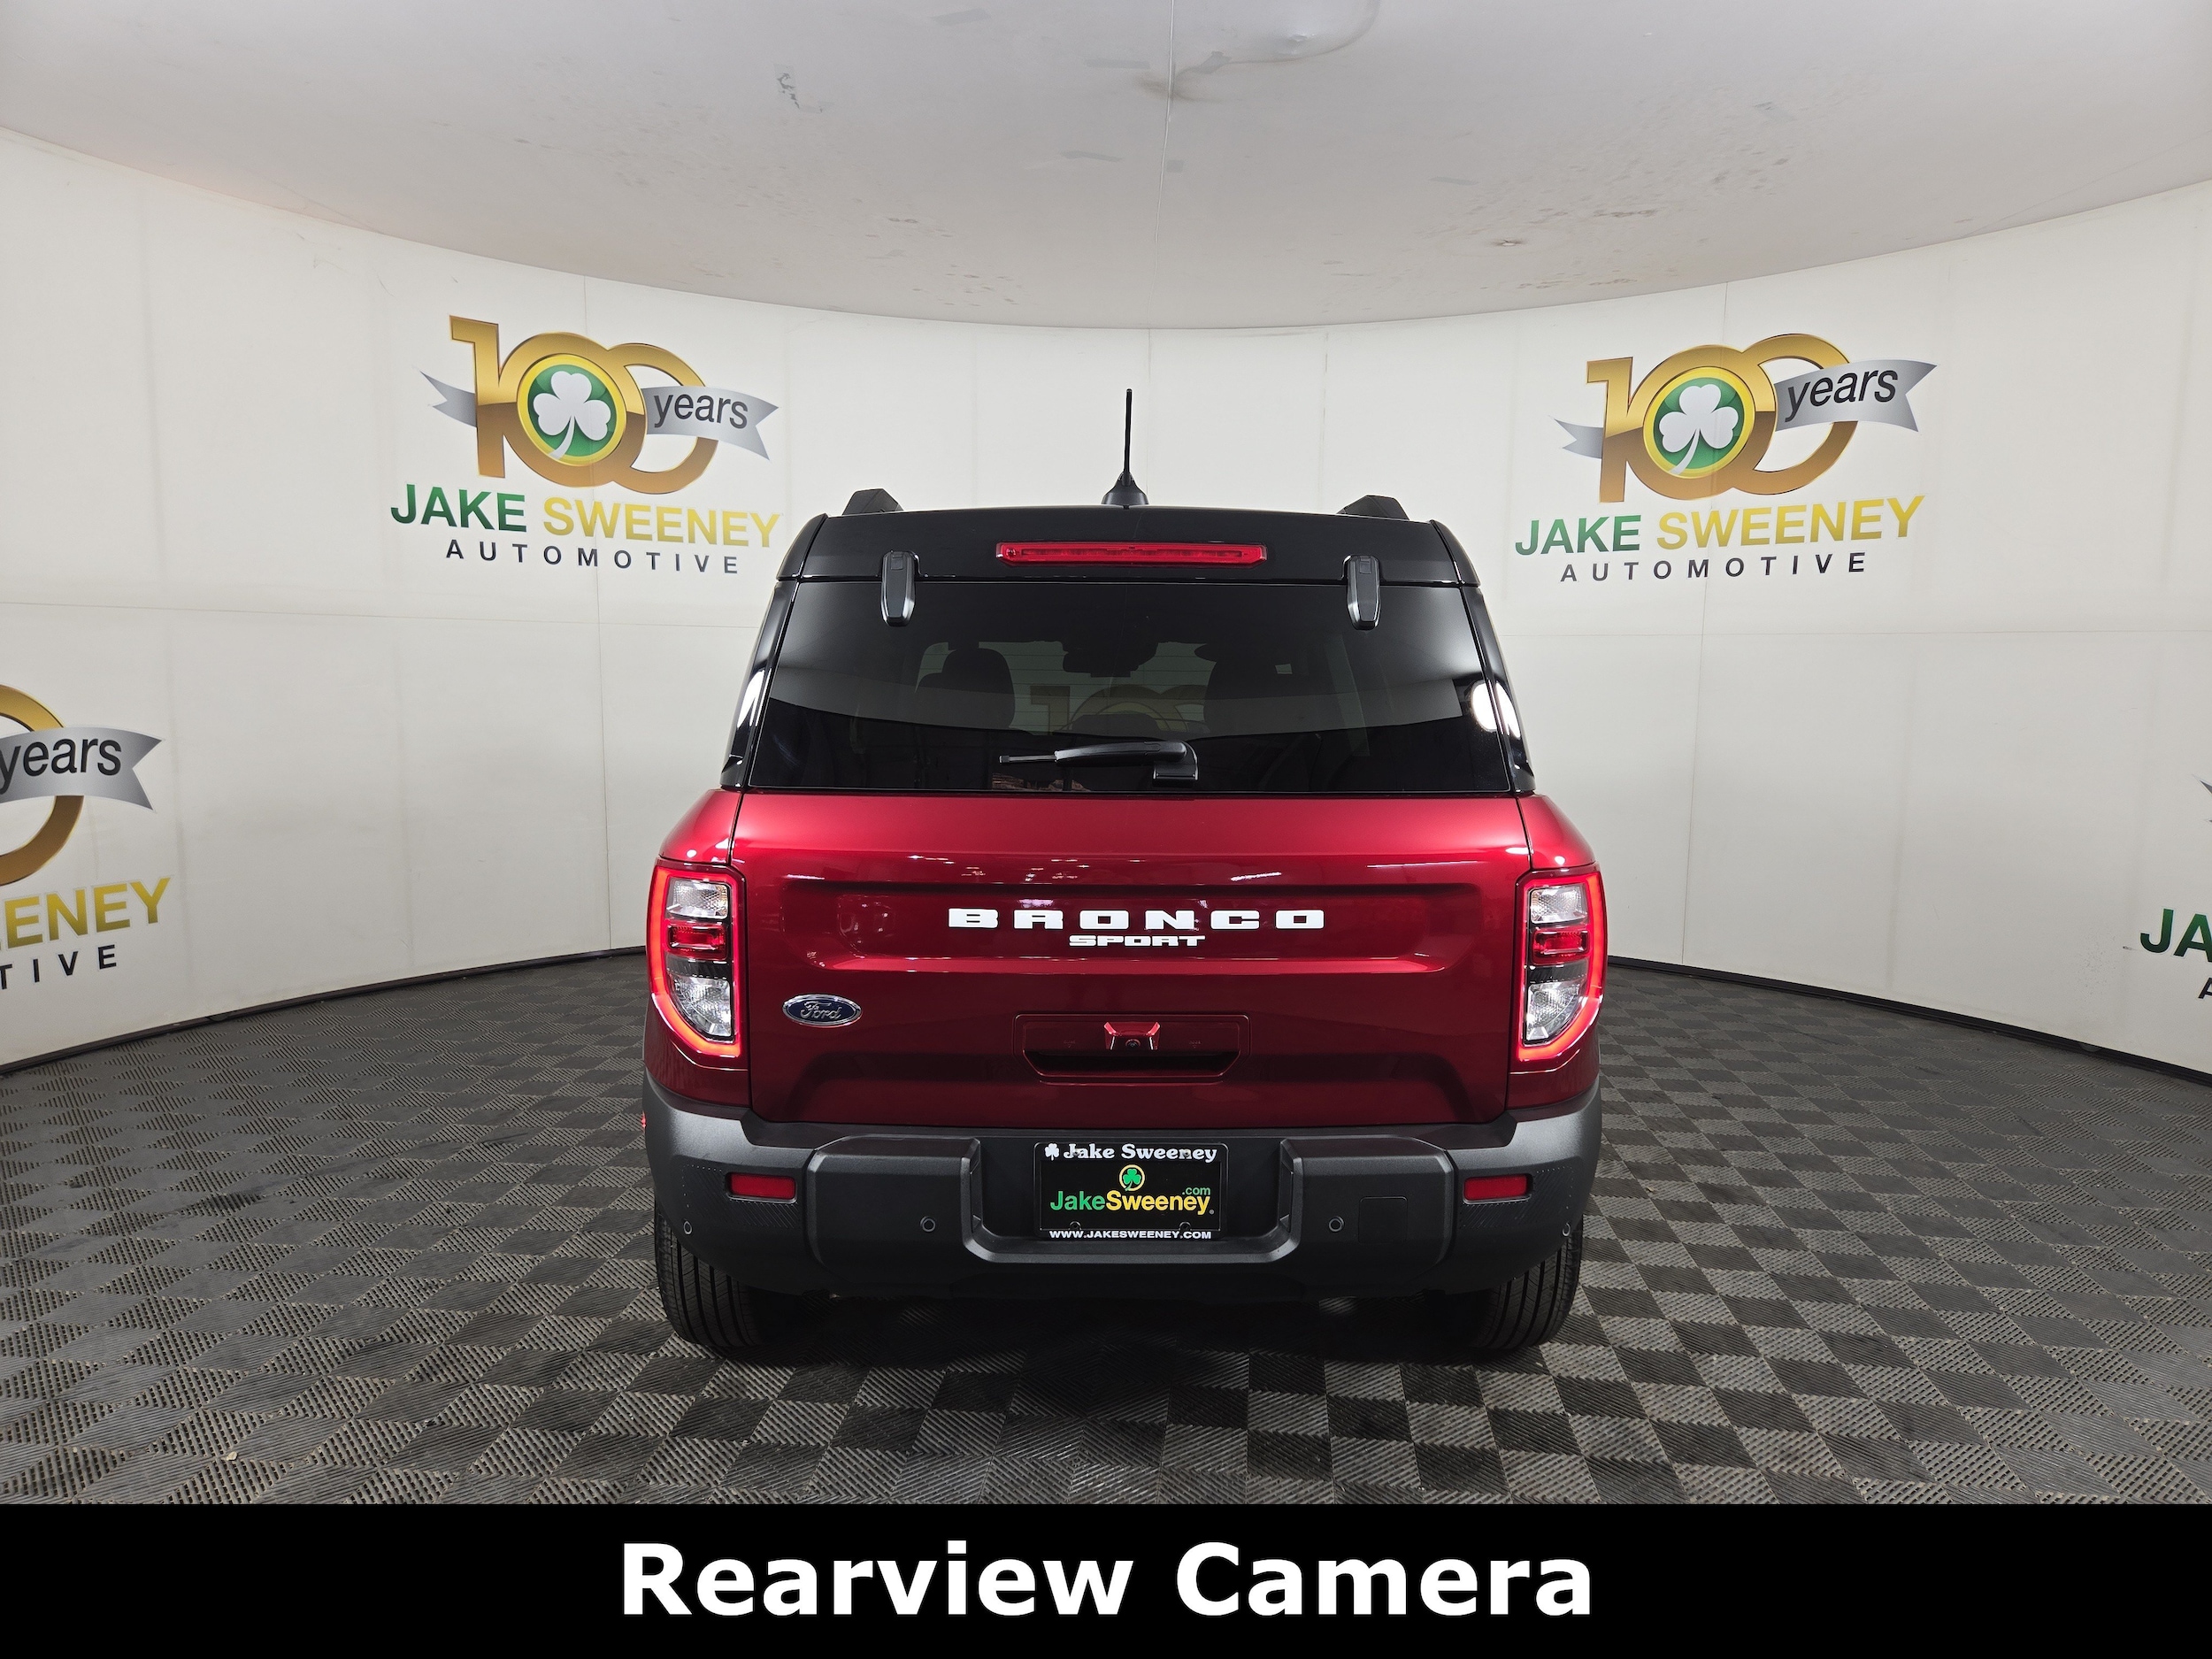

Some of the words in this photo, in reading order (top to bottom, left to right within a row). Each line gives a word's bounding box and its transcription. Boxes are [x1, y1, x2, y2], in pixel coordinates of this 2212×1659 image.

[653, 392, 749, 429] years
[1784, 368, 1898, 422] years
[390, 484, 527, 533] JAKE
[543, 496, 780, 548] SWEENEY
[1515, 515, 1641, 556] JAKE
[1656, 495, 1925, 550] SWEENEY
[446, 539, 738, 574] AUTOMOTIVE
[1560, 551, 1866, 582] AUTOMOTIVE
[0, 738, 122, 793] years
[0, 877, 172, 949] ENEY
[949, 908, 1325, 930] BRONCO
[1069, 935, 1205, 947] SPORT
[801, 1001, 842, 1019] Ford
[1064, 1143, 1115, 1159] Jake
[1121, 1143, 1217, 1163] Sweeney
